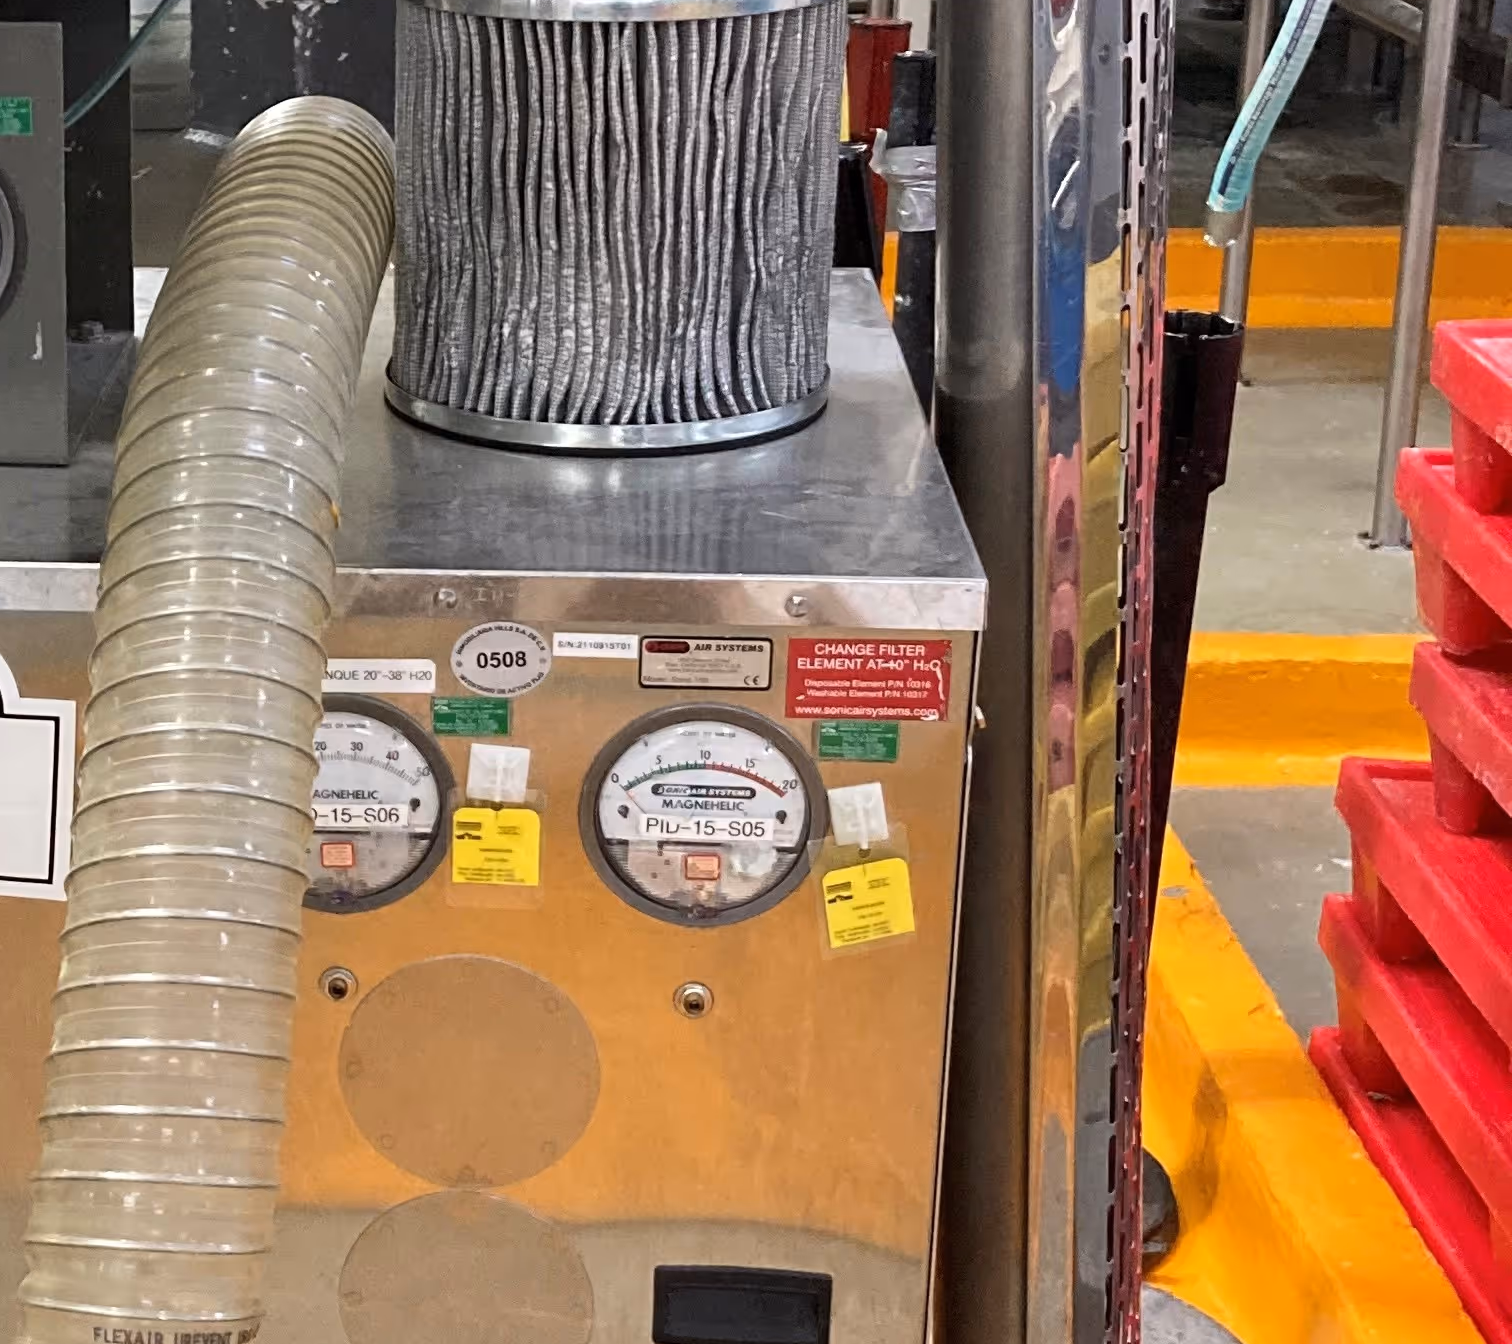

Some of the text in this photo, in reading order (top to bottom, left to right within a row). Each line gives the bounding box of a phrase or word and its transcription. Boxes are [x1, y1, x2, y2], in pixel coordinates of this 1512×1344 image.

[694, 643, 712, 651] AIR
[715, 644, 764, 652] SYSTEMS
[814, 643, 926, 656] CHANGE FILTER
[477, 650, 527, 669] 0508
[797, 658, 863, 670] ELEMENT
[866, 659, 883, 670] AT
[325, 670, 360, 681] NQUE
[804, 678, 850, 688] Disposable
[852, 679, 885, 688] Element
[806, 688, 847, 698] Washable
[849, 689, 883, 698] Element
[794, 705, 939, 718] www.sonicairsystems.com
[350, 741, 364, 752] 30
[385, 751, 400, 761] 40
[700, 750, 711, 761] 10
[745, 758, 755, 768] 15
[611, 773, 619, 783] 0
[782, 779, 798, 790] 20
[313, 790, 379, 800] AGNEHELIC
[708, 787, 752, 797] SYSTEMS
[662, 799, 745, 812] MAGNEHELIC
[313, 808, 399, 824] -15-S06
